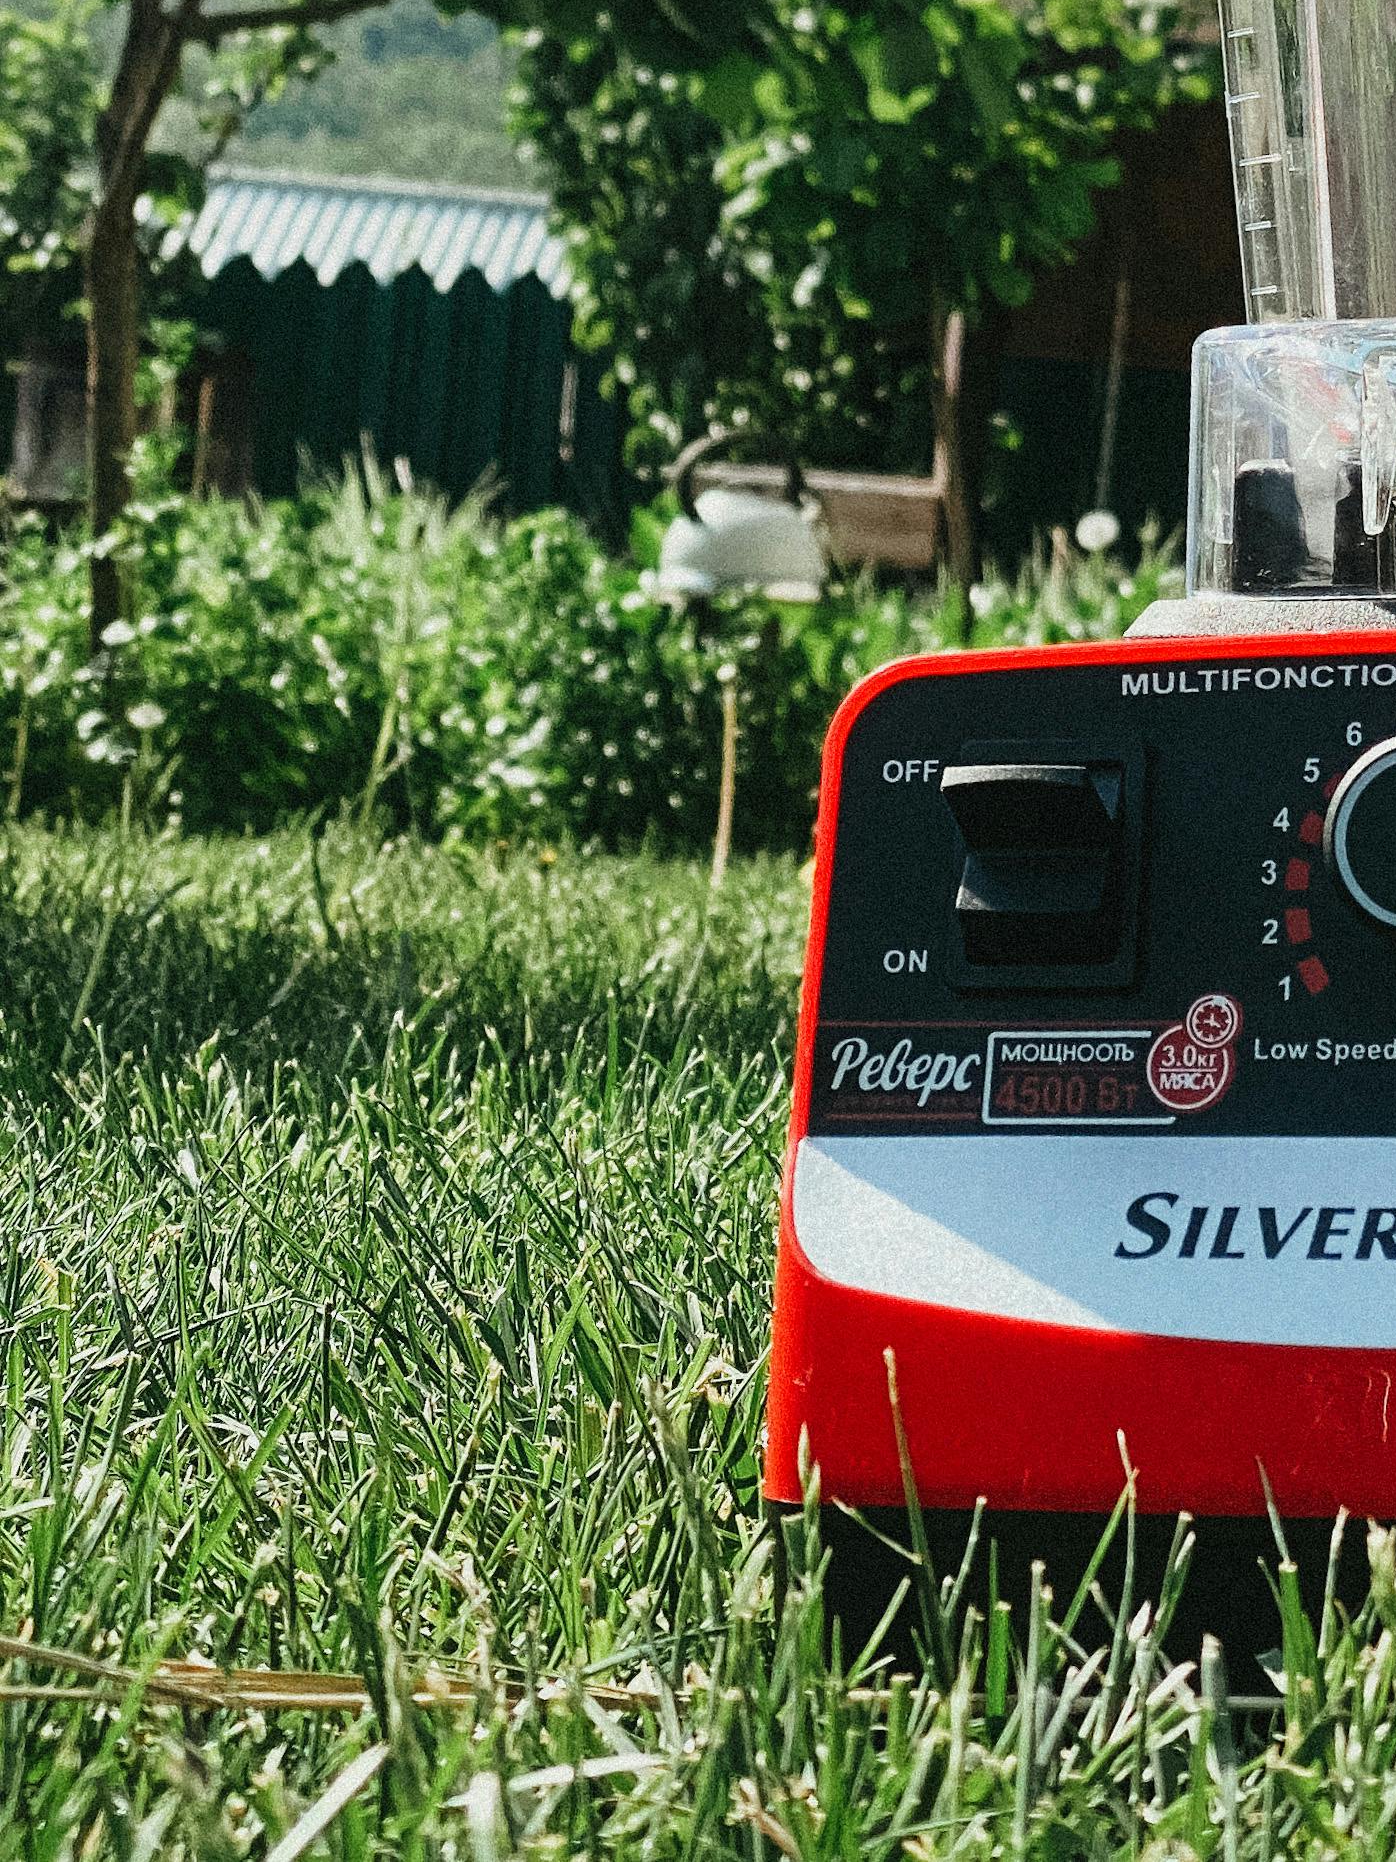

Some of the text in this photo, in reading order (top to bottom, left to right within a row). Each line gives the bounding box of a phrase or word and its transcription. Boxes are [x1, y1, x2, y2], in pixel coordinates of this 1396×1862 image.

[1346, 722, 1362, 745] 6
[882, 759, 939, 783] OFF
[1303, 757, 1320, 783] 5
[1273, 807, 1290, 832] 4
[1261, 859, 1277, 885] 3
[1262, 919, 1279, 944] 2
[883, 949, 928, 973] ON
[1279, 976, 1291, 1001] 1
[1254, 1038, 1308, 1060] Low
[831, 1037, 981, 1107] Реверс
[996, 1076, 1086, 1114] 4500
